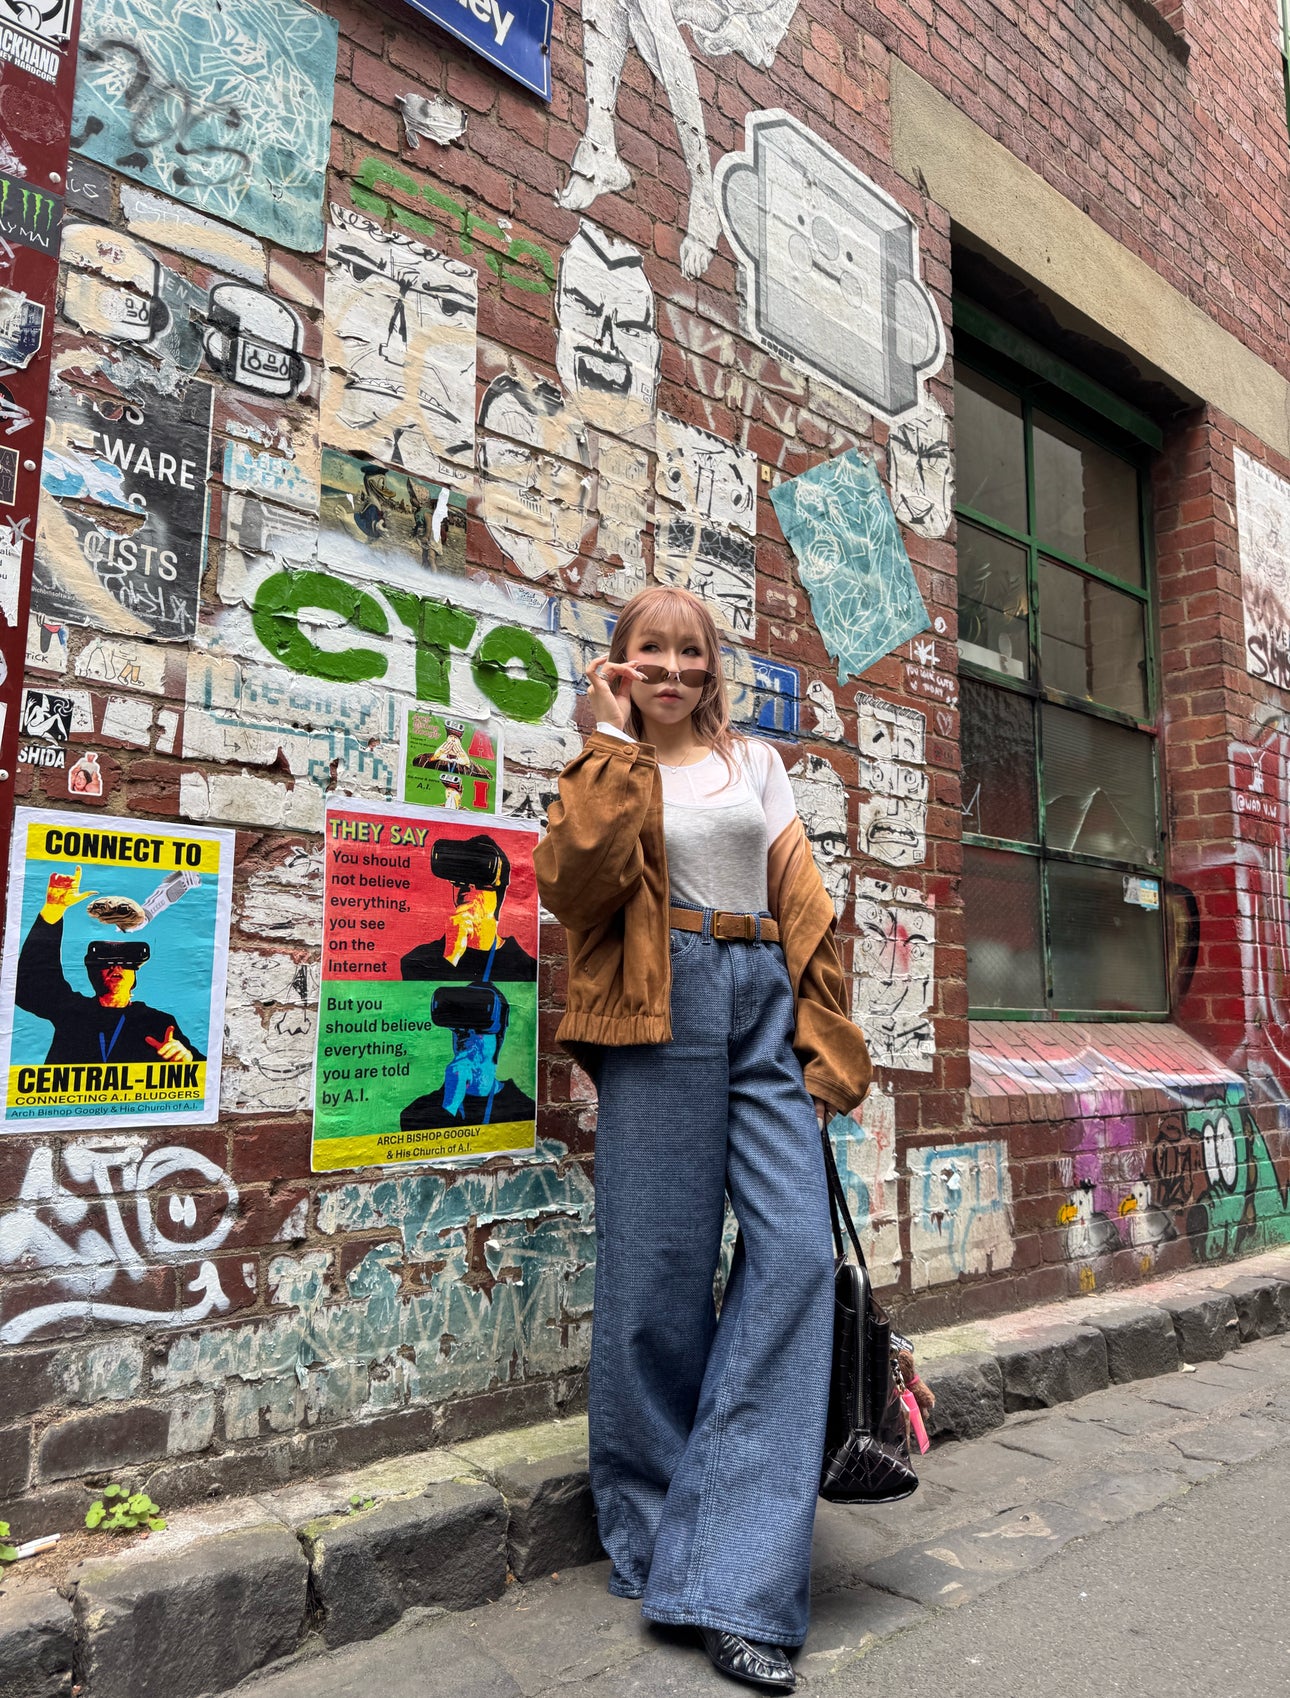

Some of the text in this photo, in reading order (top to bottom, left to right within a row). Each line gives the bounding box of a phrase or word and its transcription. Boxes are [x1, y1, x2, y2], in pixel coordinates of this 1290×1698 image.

[0, 27, 60, 77] CKHAND
[18, 746, 66, 768] SHIDA
[329, 818, 429, 847] THEY SAY
[45, 829, 201, 866] CONNECT TO
[332, 850, 411, 869] You should
[331, 874, 411, 889] not believe
[330, 896, 411, 913] everything,
[329, 918, 385, 931] you see
[329, 939, 375, 950] on the
[328, 958, 387, 973] Internet
[327, 997, 382, 1014] But you
[325, 1018, 432, 1034] should believe
[324, 1041, 407, 1059] everything,
[17, 1064, 199, 1093] CENTRAL-LINK
[322, 1062, 410, 1084] you are told
[15, 1090, 200, 1105] CONNECTING A.I. BLUDGERS
[322, 1088, 369, 1107] by A.I.
[37, 1107, 71, 1118] Bishop
[74, 1105, 108, 1116] Googly
[137, 1103, 171, 1112] Church
[172, 1102, 182, 1110] of
[183, 1102, 198, 1110] A.I.
[377, 1128, 481, 1146] ARCH BISHOP GOOGLY
[386, 1143, 472, 1159] & His Church of A.I.
